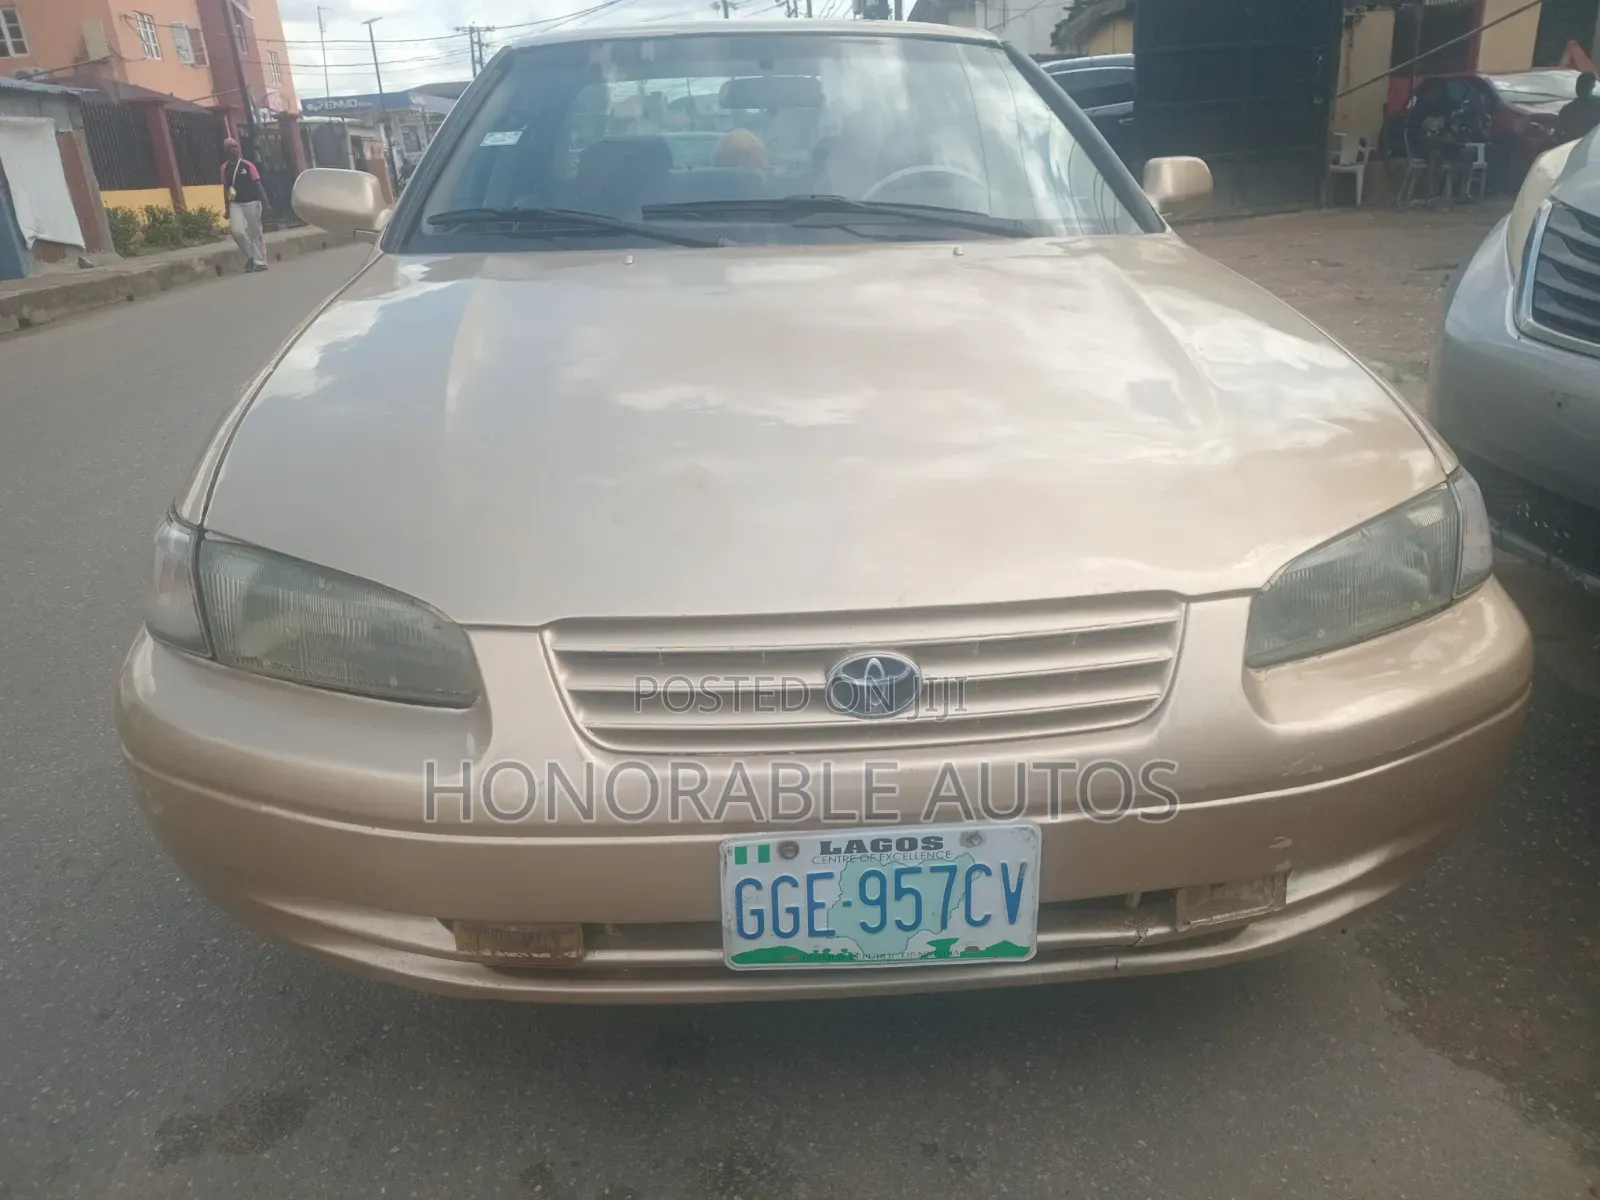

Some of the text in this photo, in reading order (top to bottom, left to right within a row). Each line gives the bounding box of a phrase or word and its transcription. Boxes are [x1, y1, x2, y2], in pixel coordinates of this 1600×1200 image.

[819, 836, 944, 856] LAGOS
[811, 850, 952, 866] CENTRE OF EXCELLENCE
[734, 860, 1029, 941] GGE-957CV
